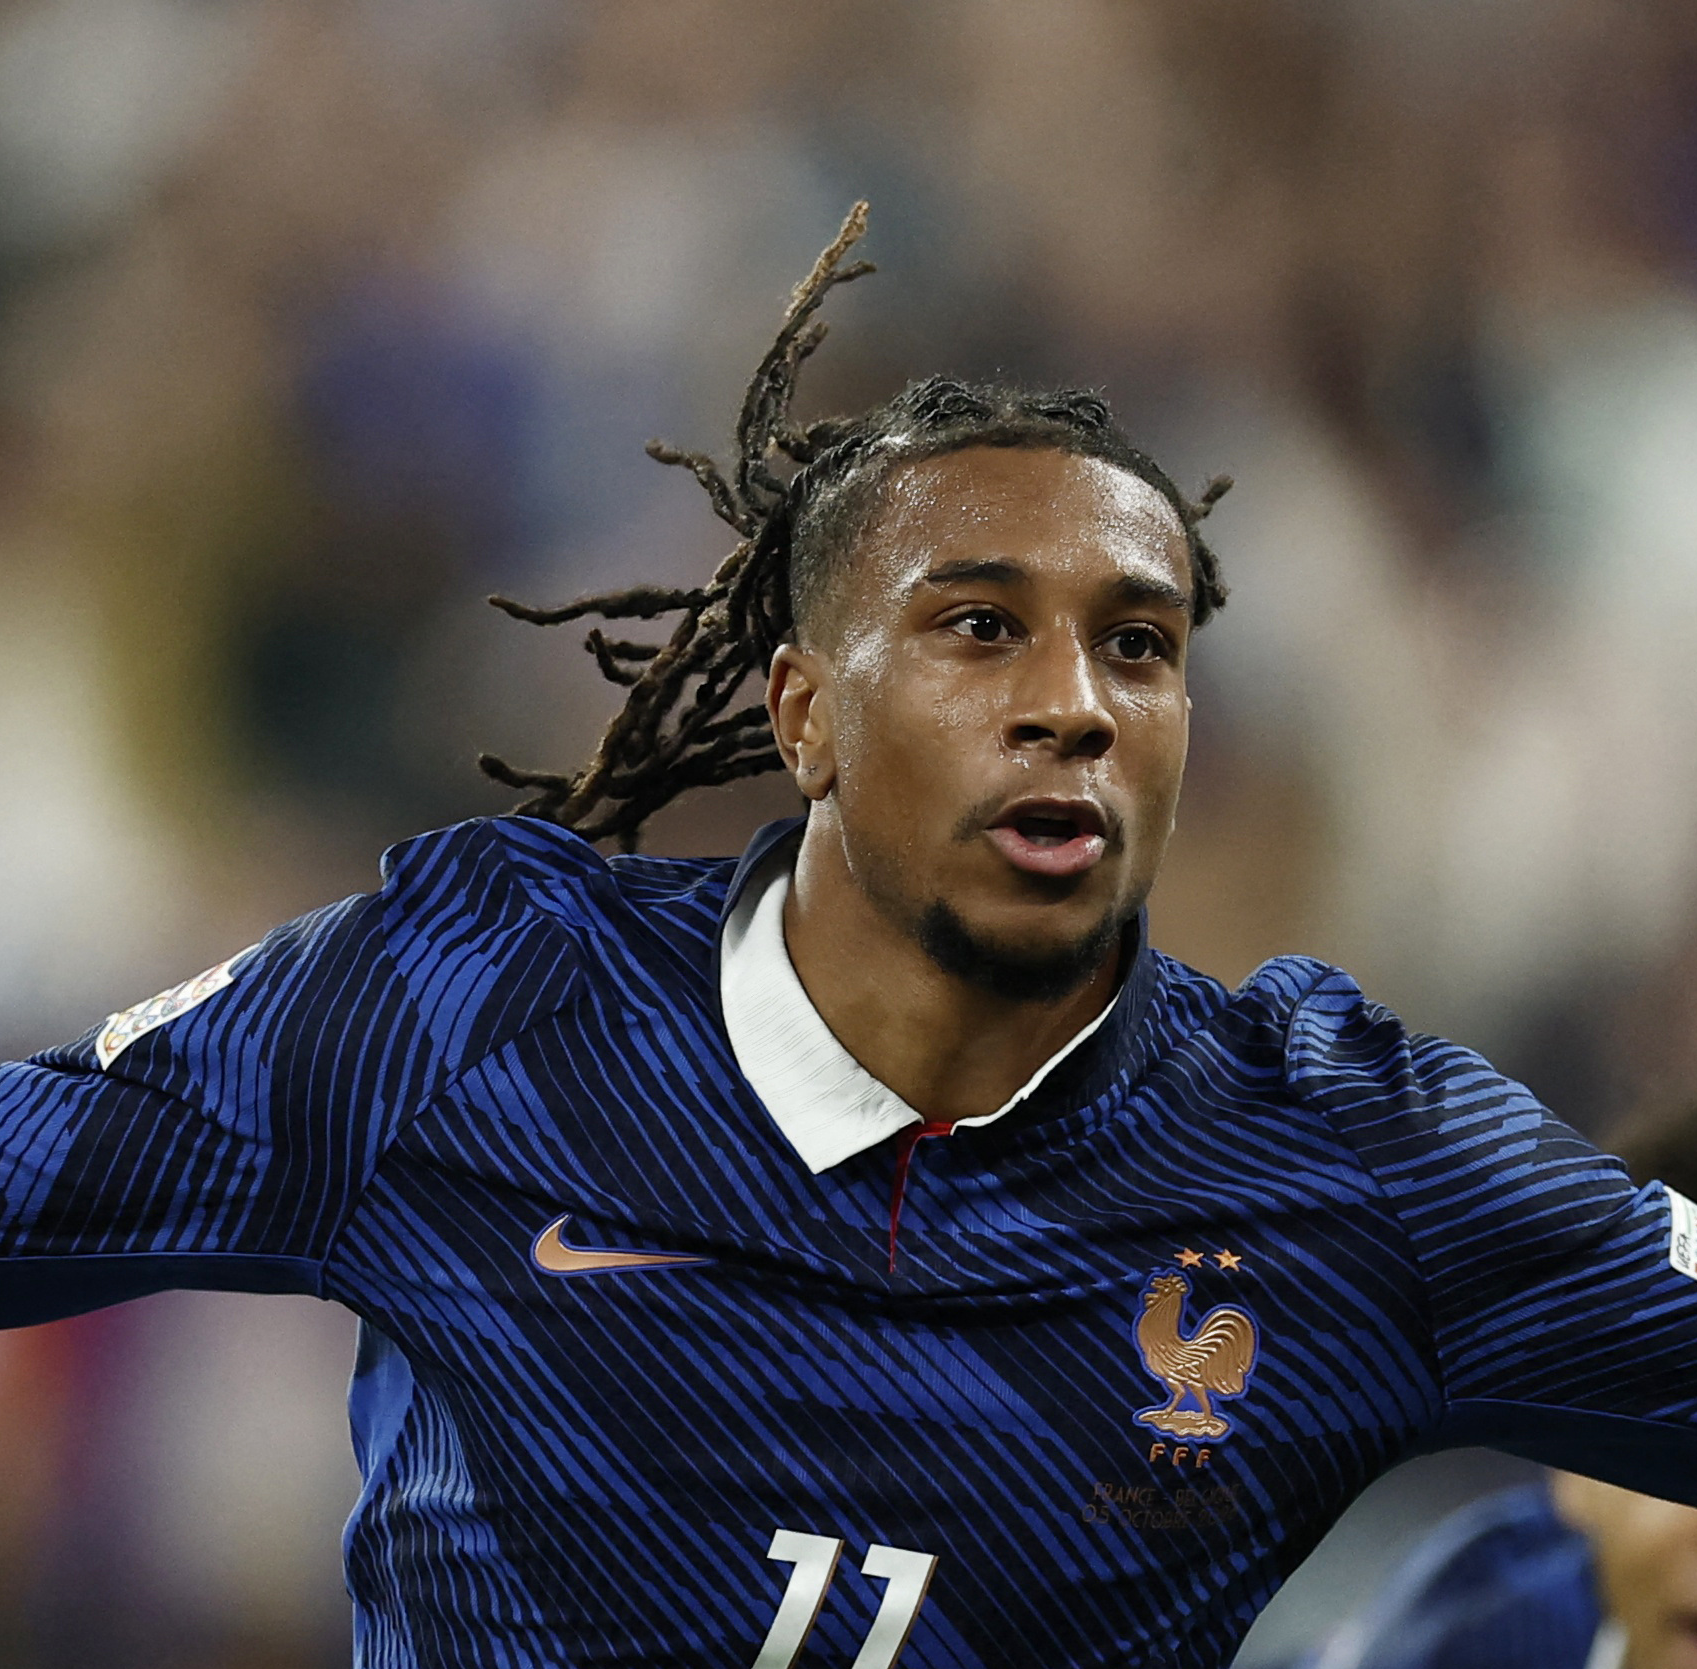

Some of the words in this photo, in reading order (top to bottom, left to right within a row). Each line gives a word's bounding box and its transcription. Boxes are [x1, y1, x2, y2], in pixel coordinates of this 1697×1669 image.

[1676, 1233, 1691, 1270] UEFA
[1149, 1443, 1211, 1468] FFF
[1093, 1482, 1157, 1506] FRANCE
